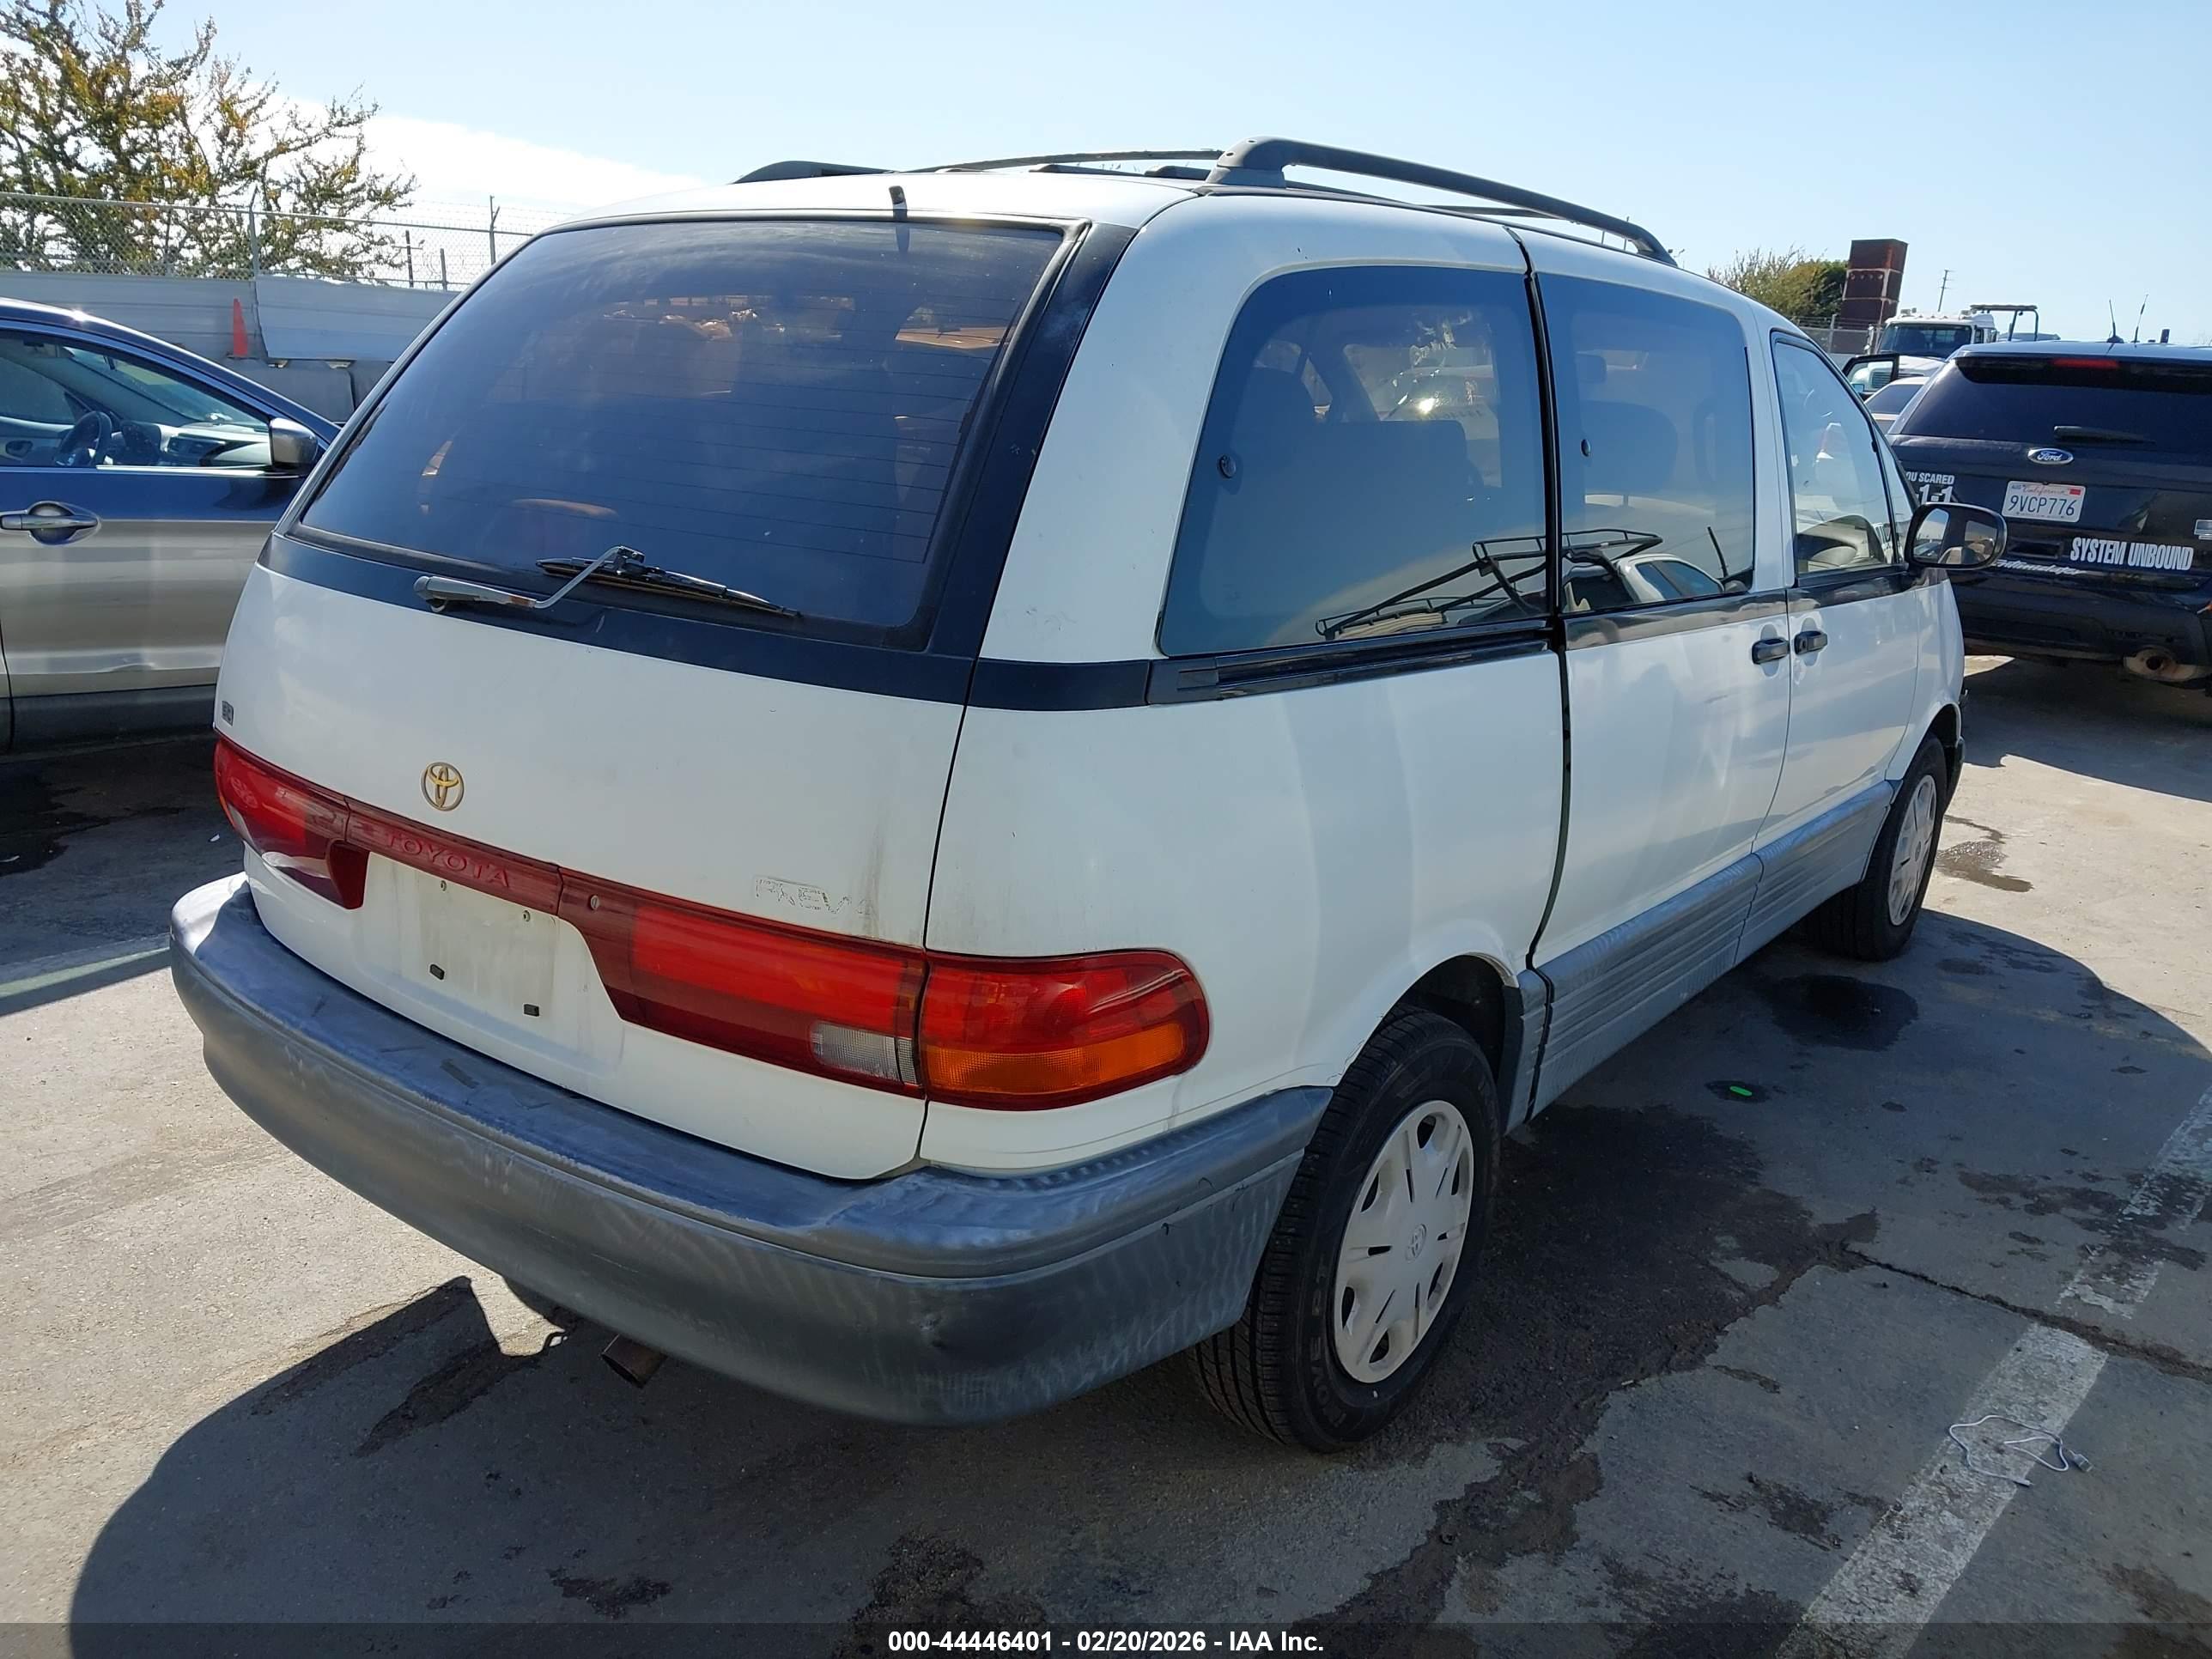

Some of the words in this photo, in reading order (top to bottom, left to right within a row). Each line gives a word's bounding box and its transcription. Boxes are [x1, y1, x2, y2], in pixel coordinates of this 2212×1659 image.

[2036, 450, 2063, 461] Ford
[1906, 471, 1918, 482] OU
[1918, 472, 1955, 484] SCARED
[2008, 495, 2077, 516] 9VCP776
[2069, 537, 2127, 566] SYSTEM
[2127, 542, 2195, 571] UNBOUND
[386, 834, 509, 888] TOYOTA
